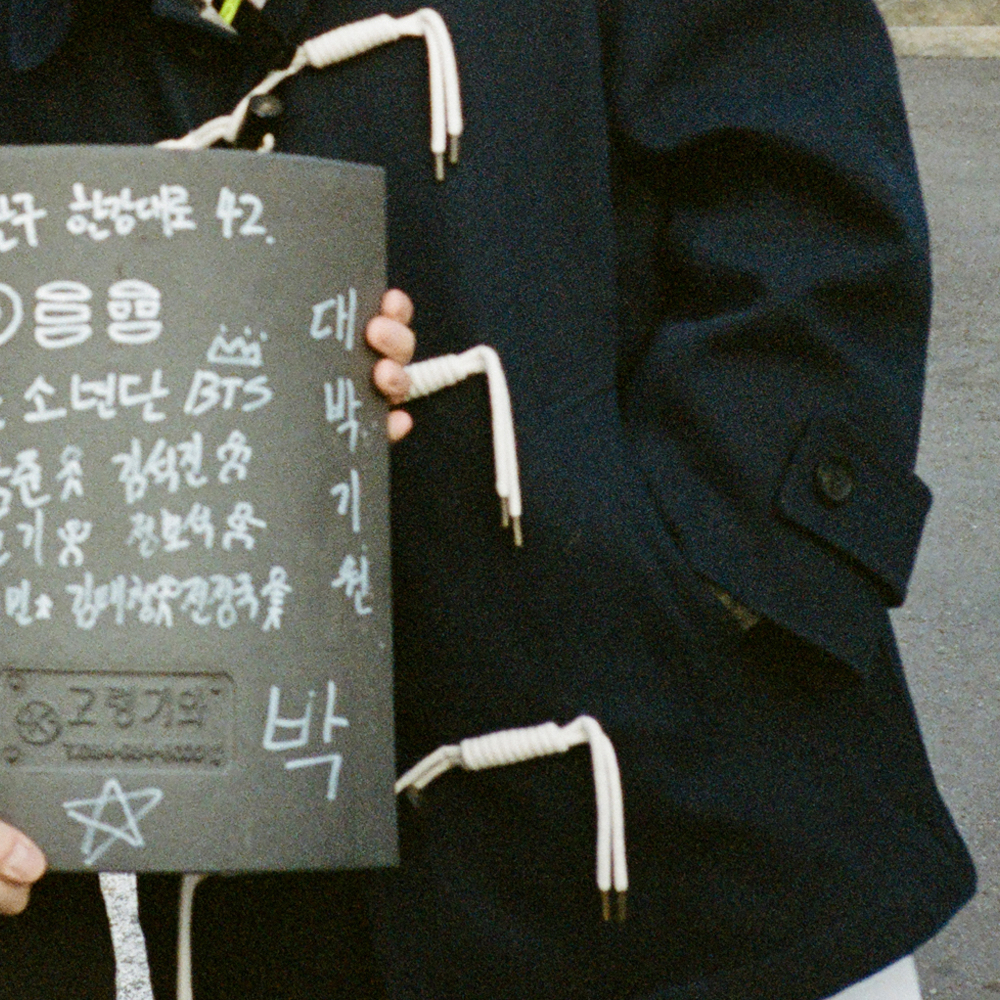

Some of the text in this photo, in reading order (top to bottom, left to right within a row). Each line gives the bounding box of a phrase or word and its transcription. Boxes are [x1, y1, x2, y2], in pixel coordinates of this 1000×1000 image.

[66, 182, 197, 241] 한강대로
[184, 369, 273, 416] BTS
[112, 431, 207, 504] 김석진
[262, 679, 350, 802] 박
